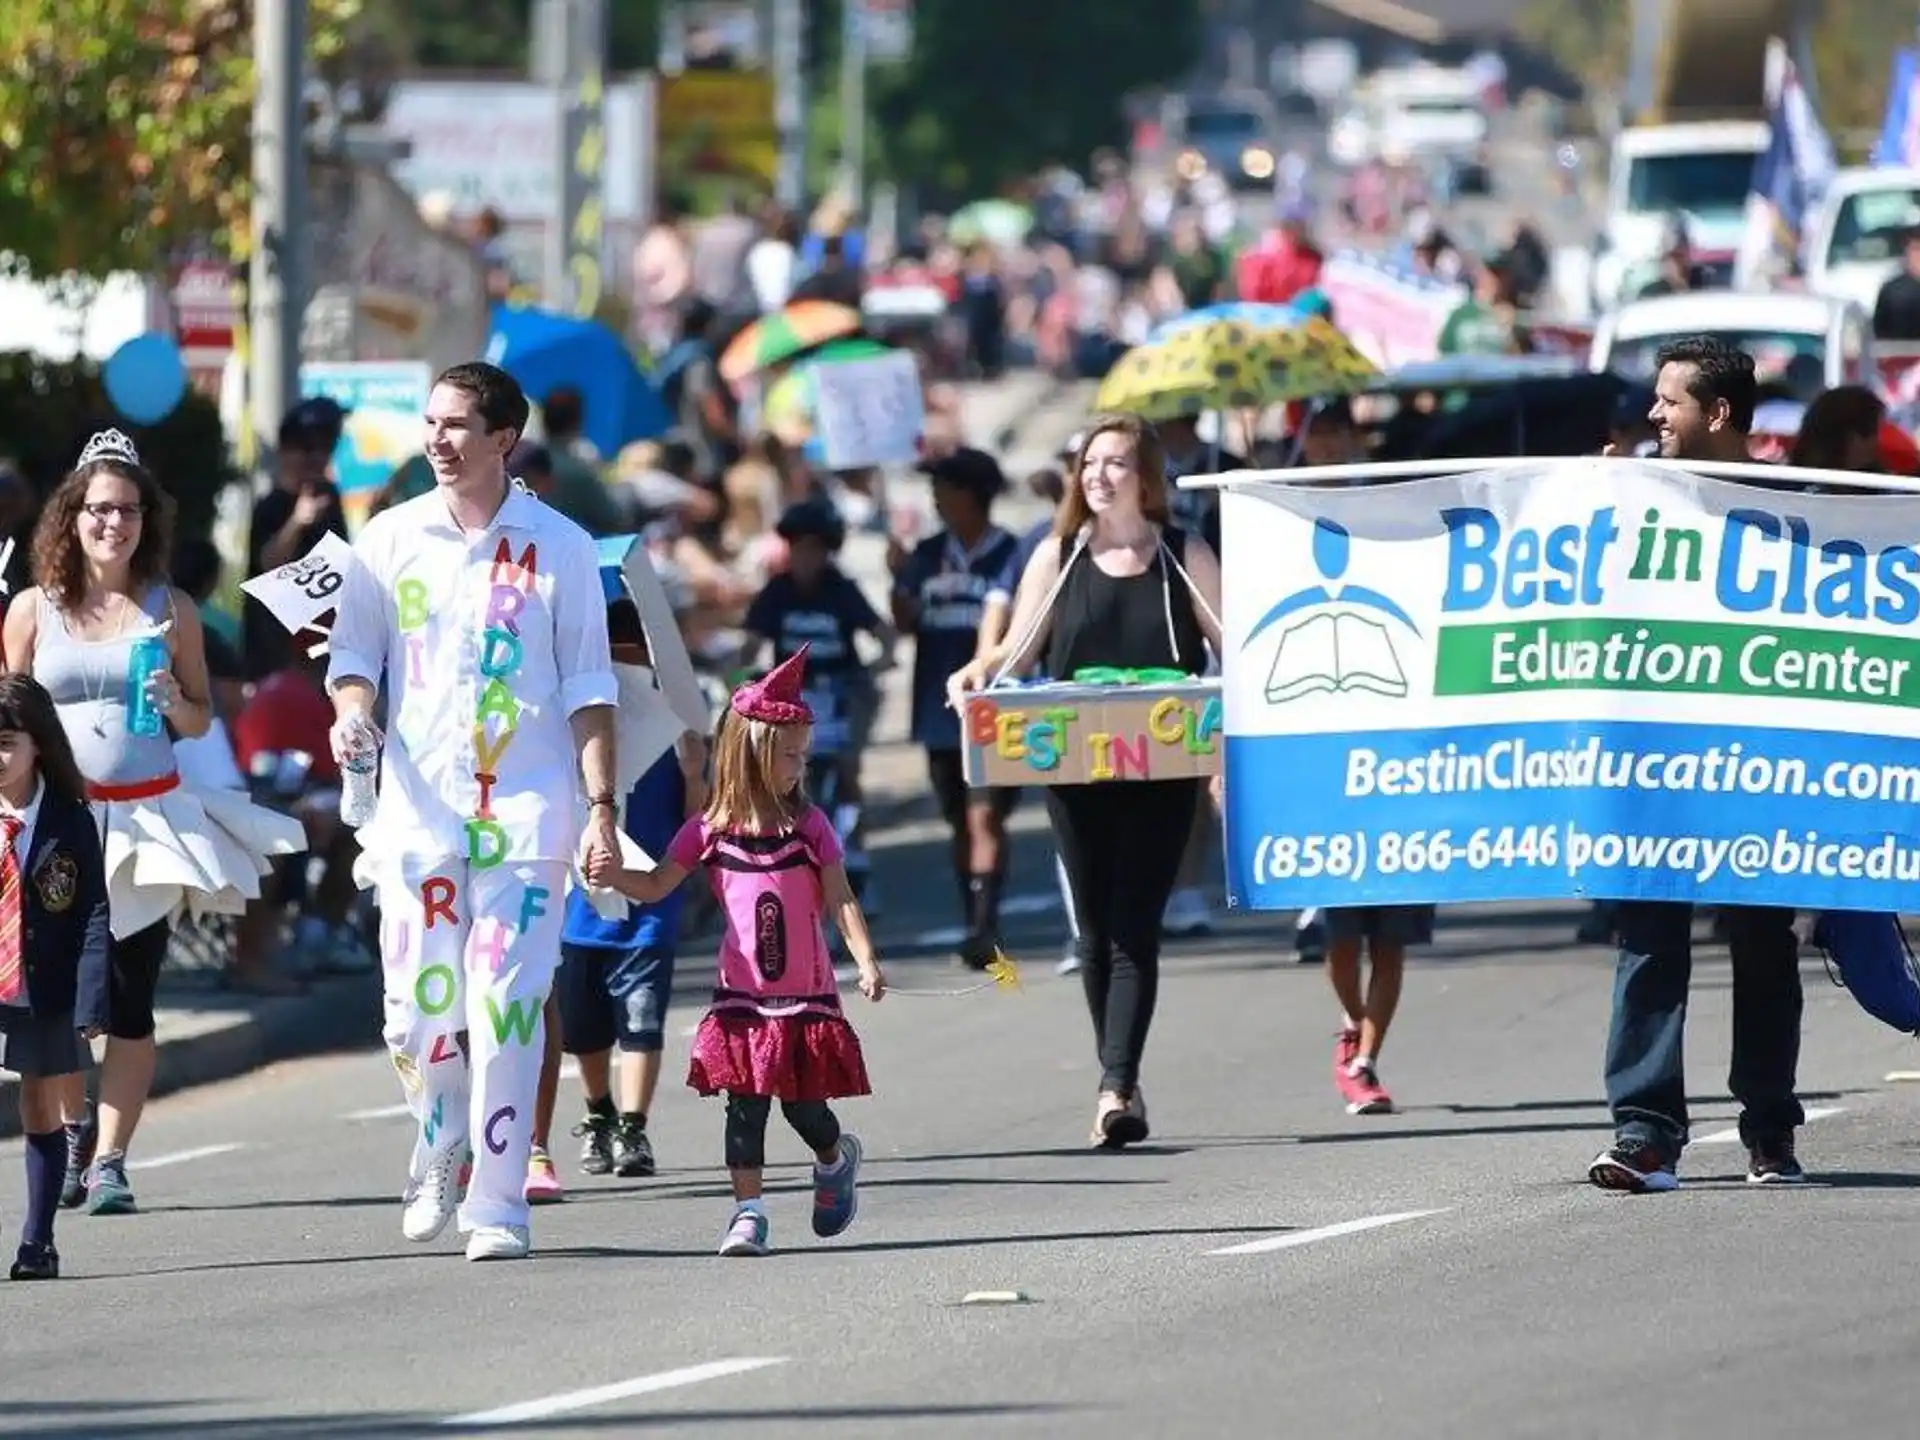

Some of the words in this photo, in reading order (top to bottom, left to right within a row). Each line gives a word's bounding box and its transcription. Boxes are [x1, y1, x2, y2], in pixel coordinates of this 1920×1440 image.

[1440, 505, 1620, 612] Best
[1628, 507, 1702, 581] in
[1715, 508, 1920, 625] Clas
[1739, 634, 1910, 696] Center
[968, 697, 1078, 771] BEST
[1088, 731, 1149, 780] IN
[1253, 830, 1367, 884] (858)
[1376, 823, 1559, 874] 866-6446
